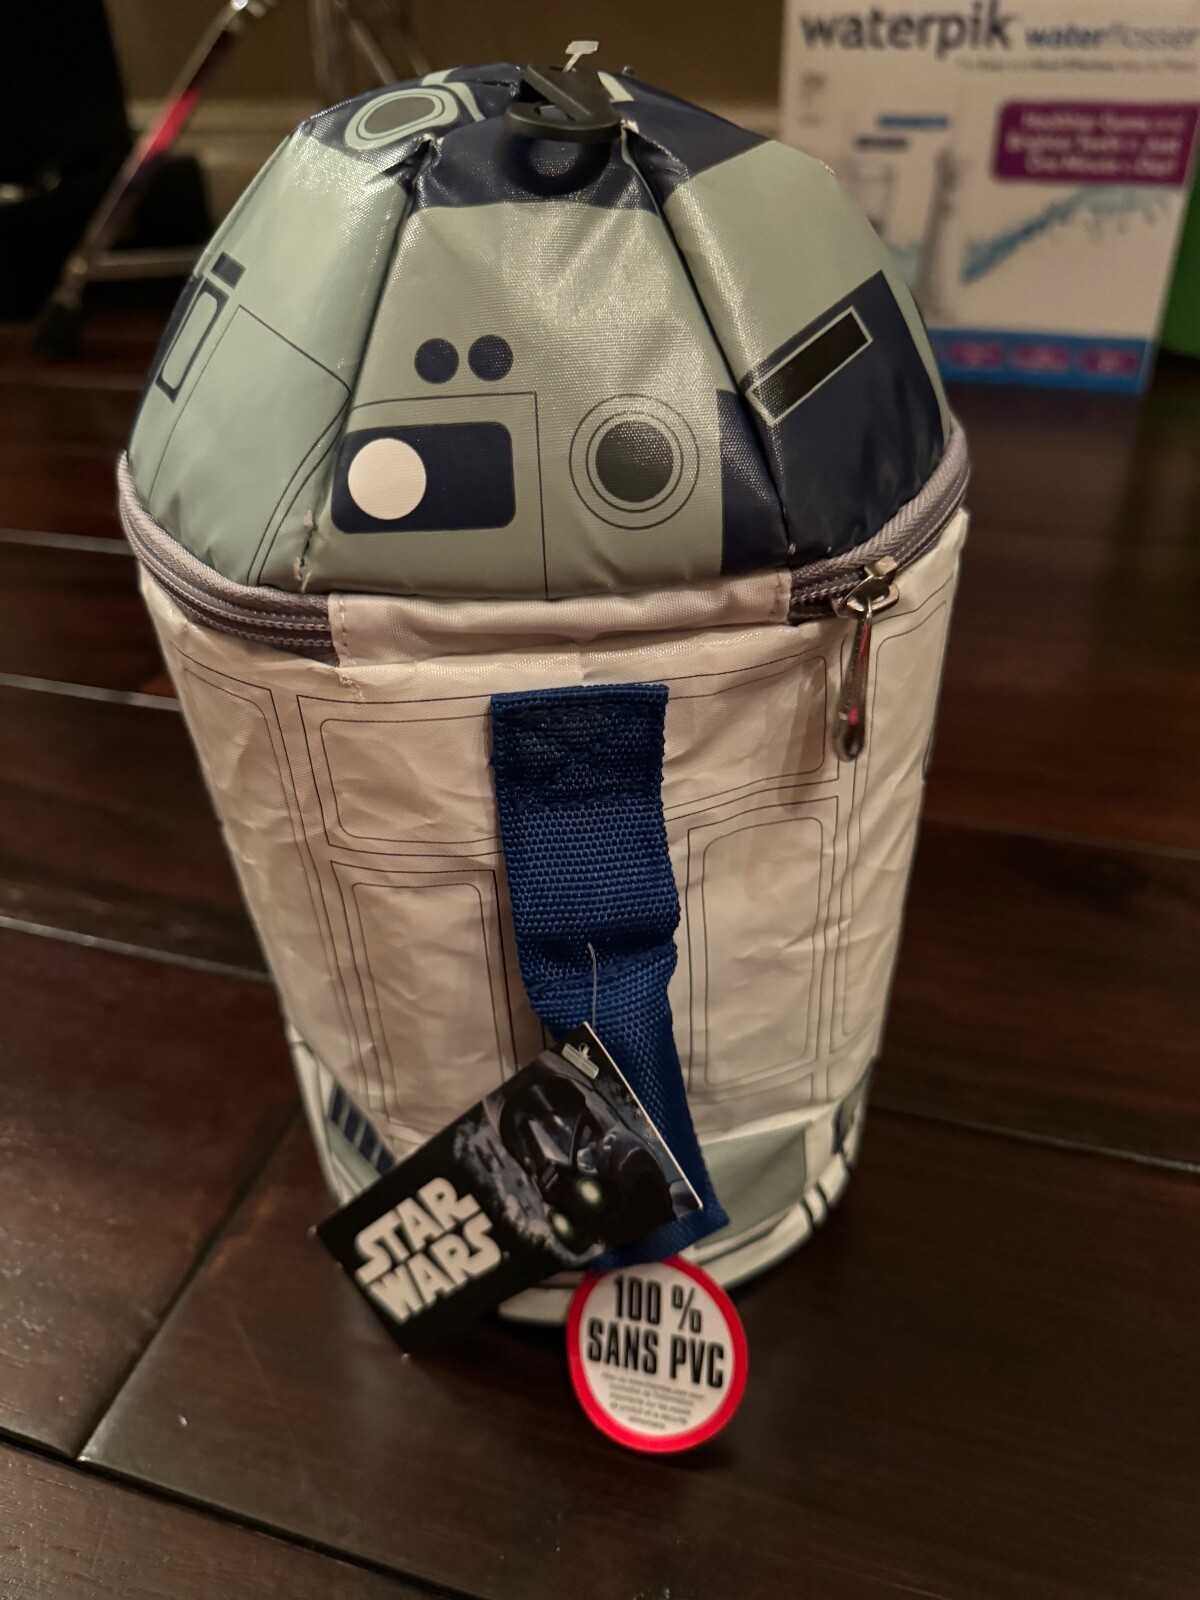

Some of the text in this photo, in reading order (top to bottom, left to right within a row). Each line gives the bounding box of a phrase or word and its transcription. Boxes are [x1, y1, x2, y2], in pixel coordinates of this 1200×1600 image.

[799, 0, 1014, 60] waterpik
[355, 1176, 482, 1283] STAR
[364, 1212, 502, 1324] WARS
[614, 1274, 703, 1333] 100 %
[587, 1316, 659, 1375] SANS
[669, 1333, 725, 1389] PVC
